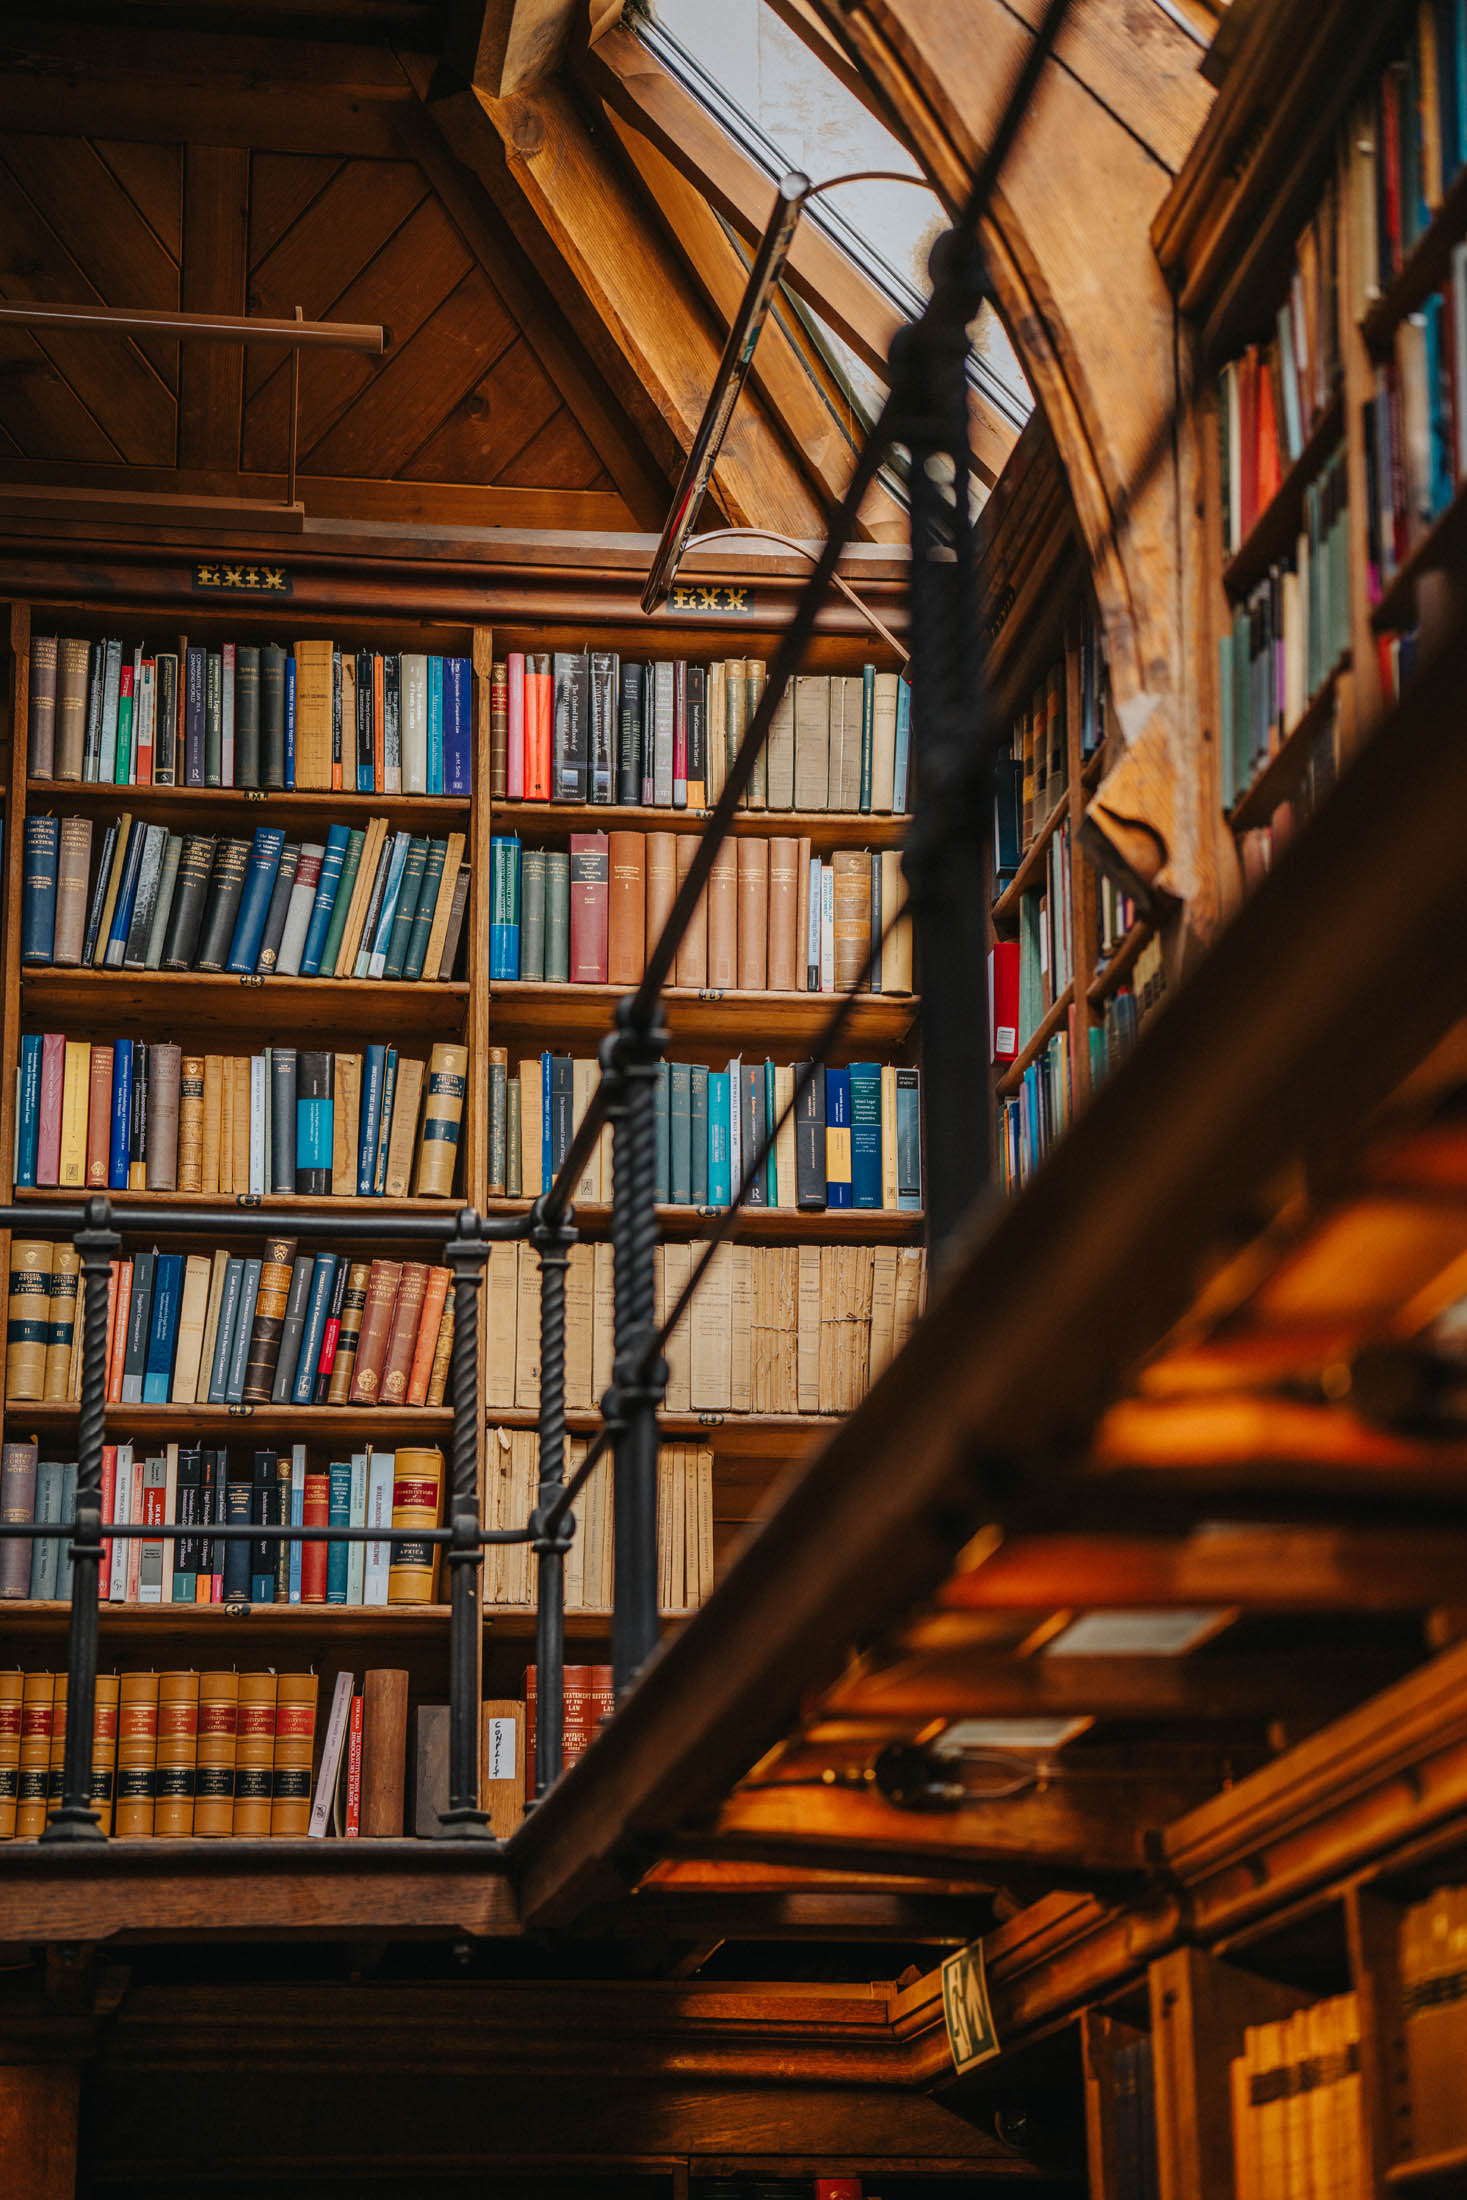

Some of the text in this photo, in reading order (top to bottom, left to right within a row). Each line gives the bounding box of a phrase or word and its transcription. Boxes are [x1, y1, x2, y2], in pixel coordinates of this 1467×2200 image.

[137, 1294, 145, 1313] Negative
[134, 1313, 143, 1342] Comparative
[203, 1491, 211, 1504] Legal
[200, 1546, 208, 1566] Disputes
